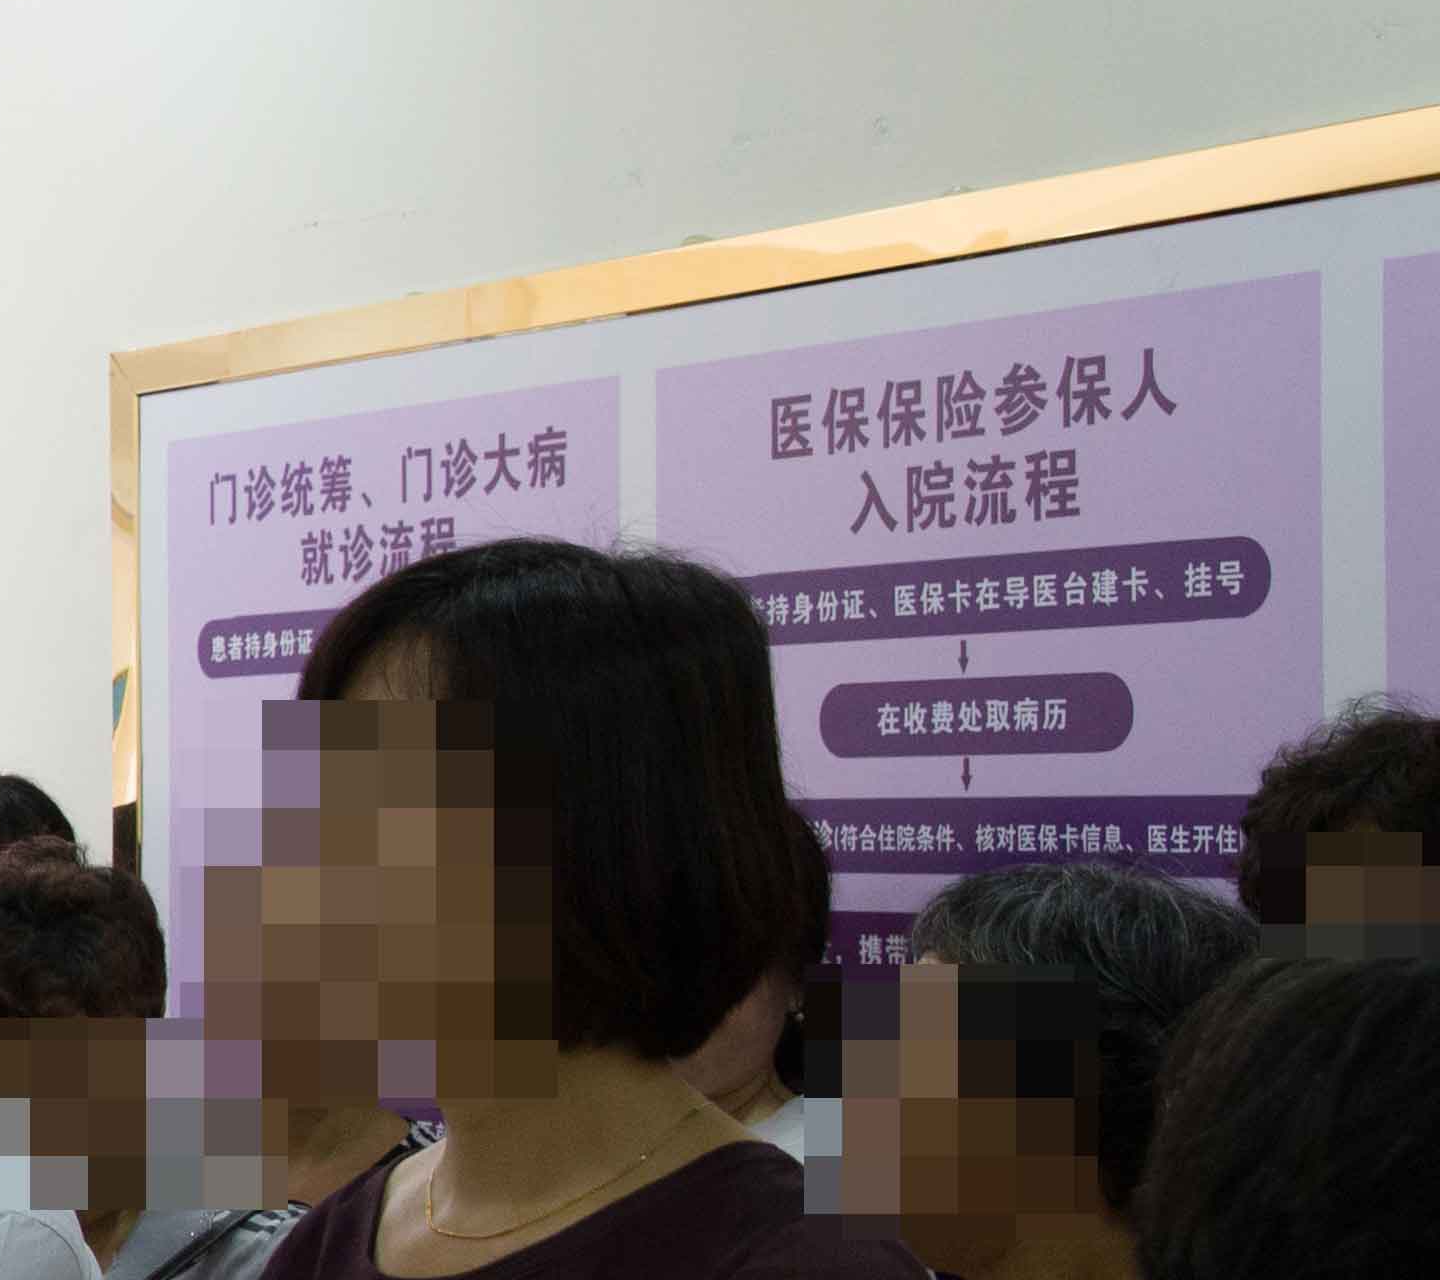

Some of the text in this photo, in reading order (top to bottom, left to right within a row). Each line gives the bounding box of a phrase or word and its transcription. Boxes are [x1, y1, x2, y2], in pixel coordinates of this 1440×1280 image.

[770, 347, 1178, 460] 医保保险参保人
[209, 426, 568, 526] 门诊统筹、门诊大病
[849, 448, 1082, 535] 入院流程
[300, 517, 457, 586] 就诊流程
[750, 560, 1244, 626] 持身份证、医保卡在导医台建卡、挂号
[210, 628, 313, 663] 患者持身份证
[877, 698, 1067, 737] 在收费处取病历
